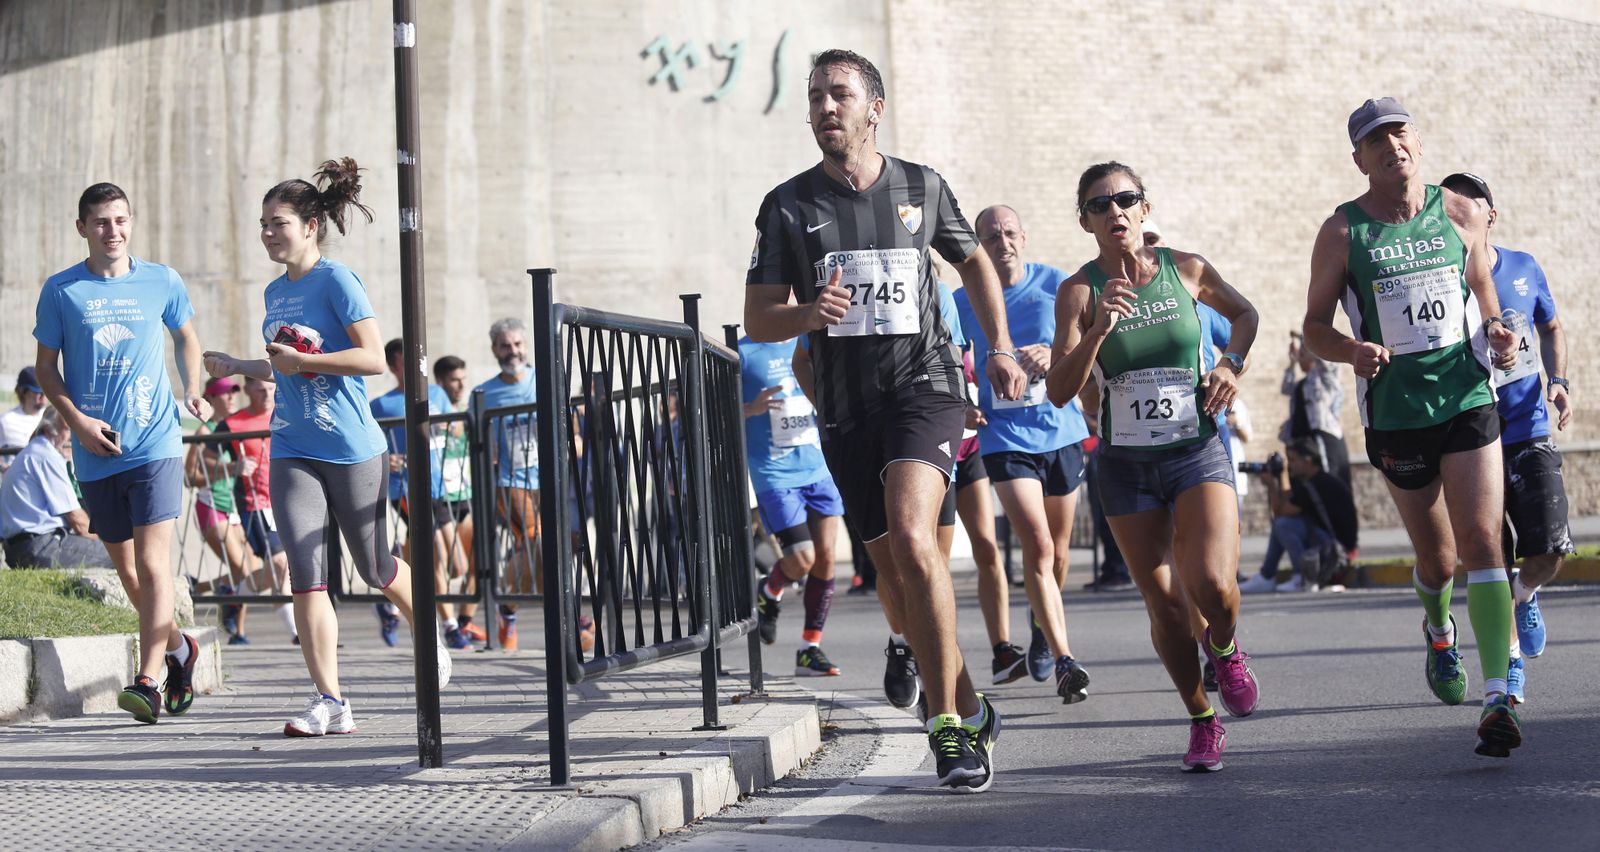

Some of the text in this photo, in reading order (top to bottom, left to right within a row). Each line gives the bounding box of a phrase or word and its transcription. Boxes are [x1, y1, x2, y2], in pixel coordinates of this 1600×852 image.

[1368, 236, 1446, 263] mijas
[1378, 256, 1446, 276] ATLETISMO
[1402, 281, 1425, 290] CIUDAD
[1403, 273, 1431, 283] CARRERA
[844, 282, 906, 306] 2745
[82, 317, 106, 325] CIUDAD
[84, 309, 113, 318] CARRERA
[1402, 300, 1446, 325] 140
[1116, 313, 1180, 333] ATLETISMO
[98, 356, 132, 369] Unicaja
[300, 384, 311, 419] Renault
[1130, 398, 1174, 420] 123
[780, 415, 810, 430] 3385
